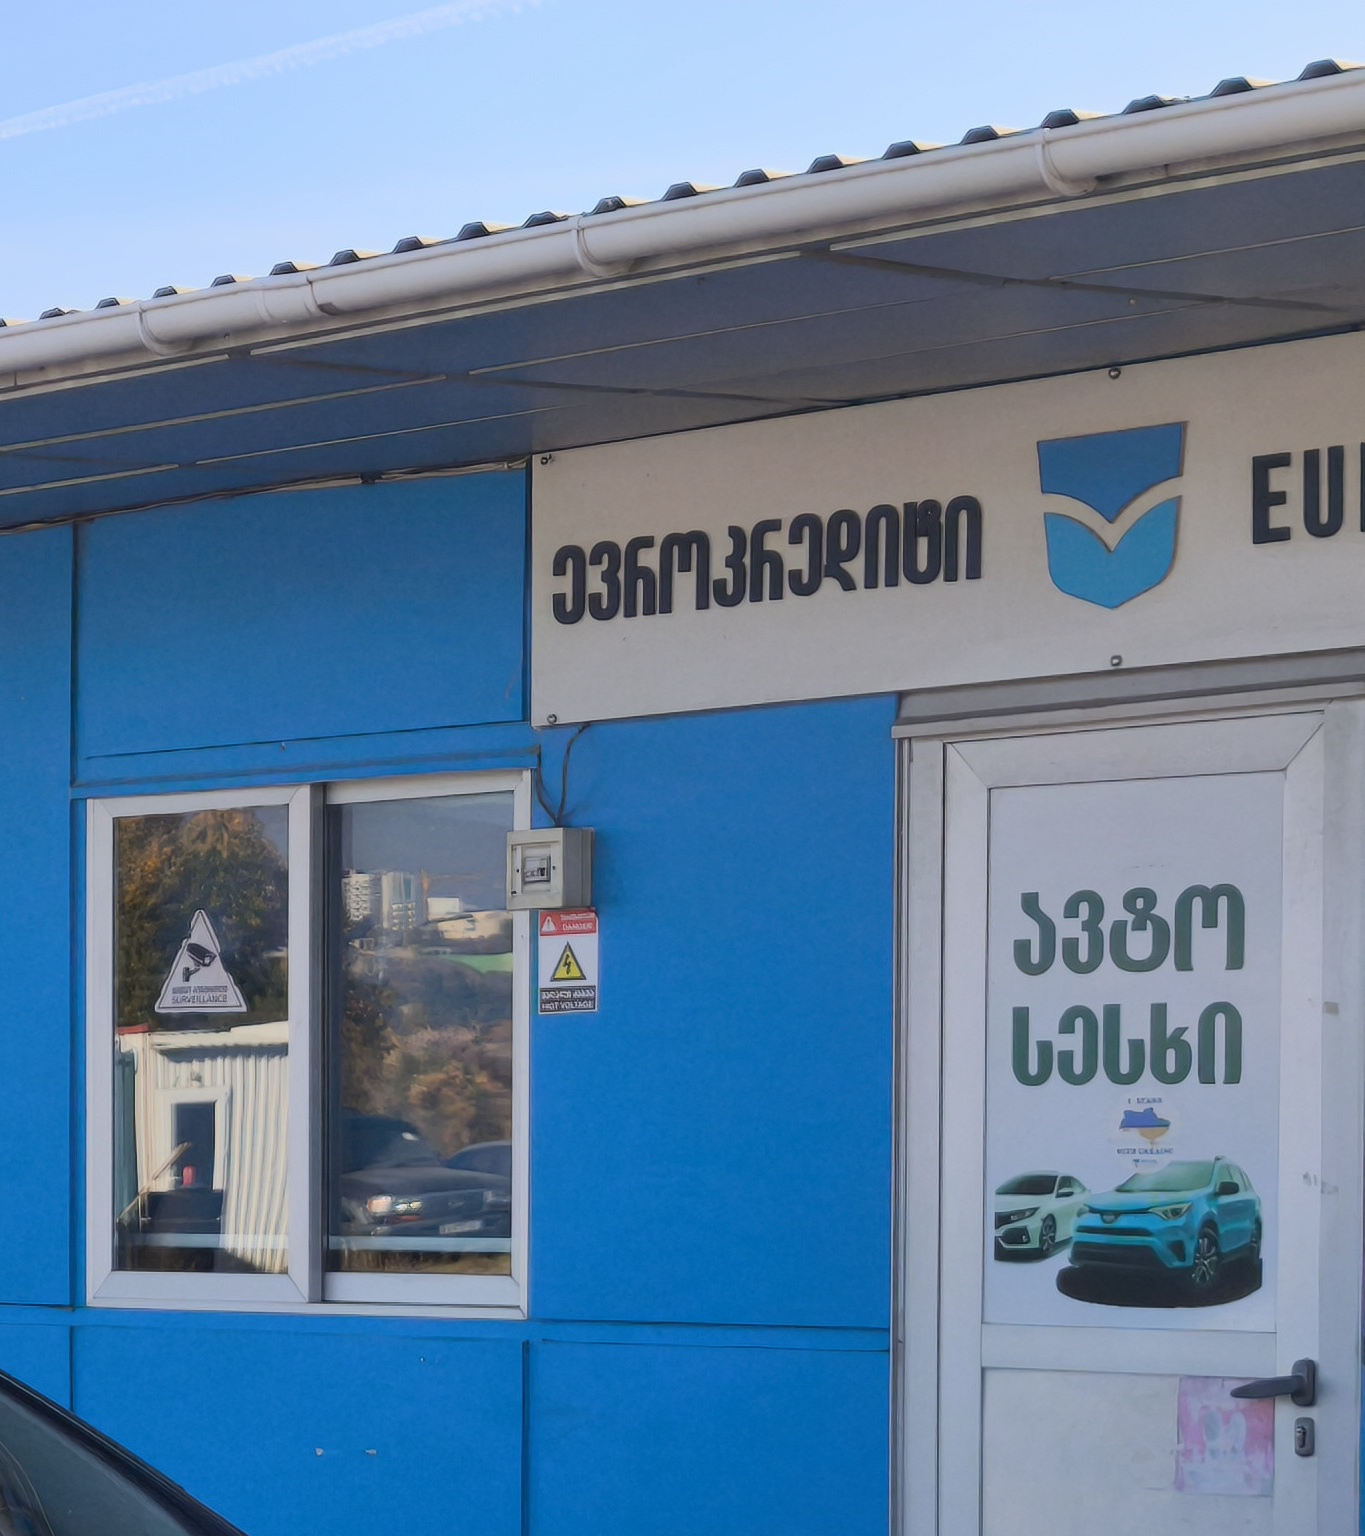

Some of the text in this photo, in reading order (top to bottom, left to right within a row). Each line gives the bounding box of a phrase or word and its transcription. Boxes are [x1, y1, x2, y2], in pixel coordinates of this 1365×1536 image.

[1251, 443, 1365, 545] EU
[552, 494, 984, 625] ევროკრედიტი
[1013, 883, 1246, 976] ავტო
[172, 995, 227, 1003] SURVEILLANCE
[1011, 1000, 1243, 1086] სესხი
